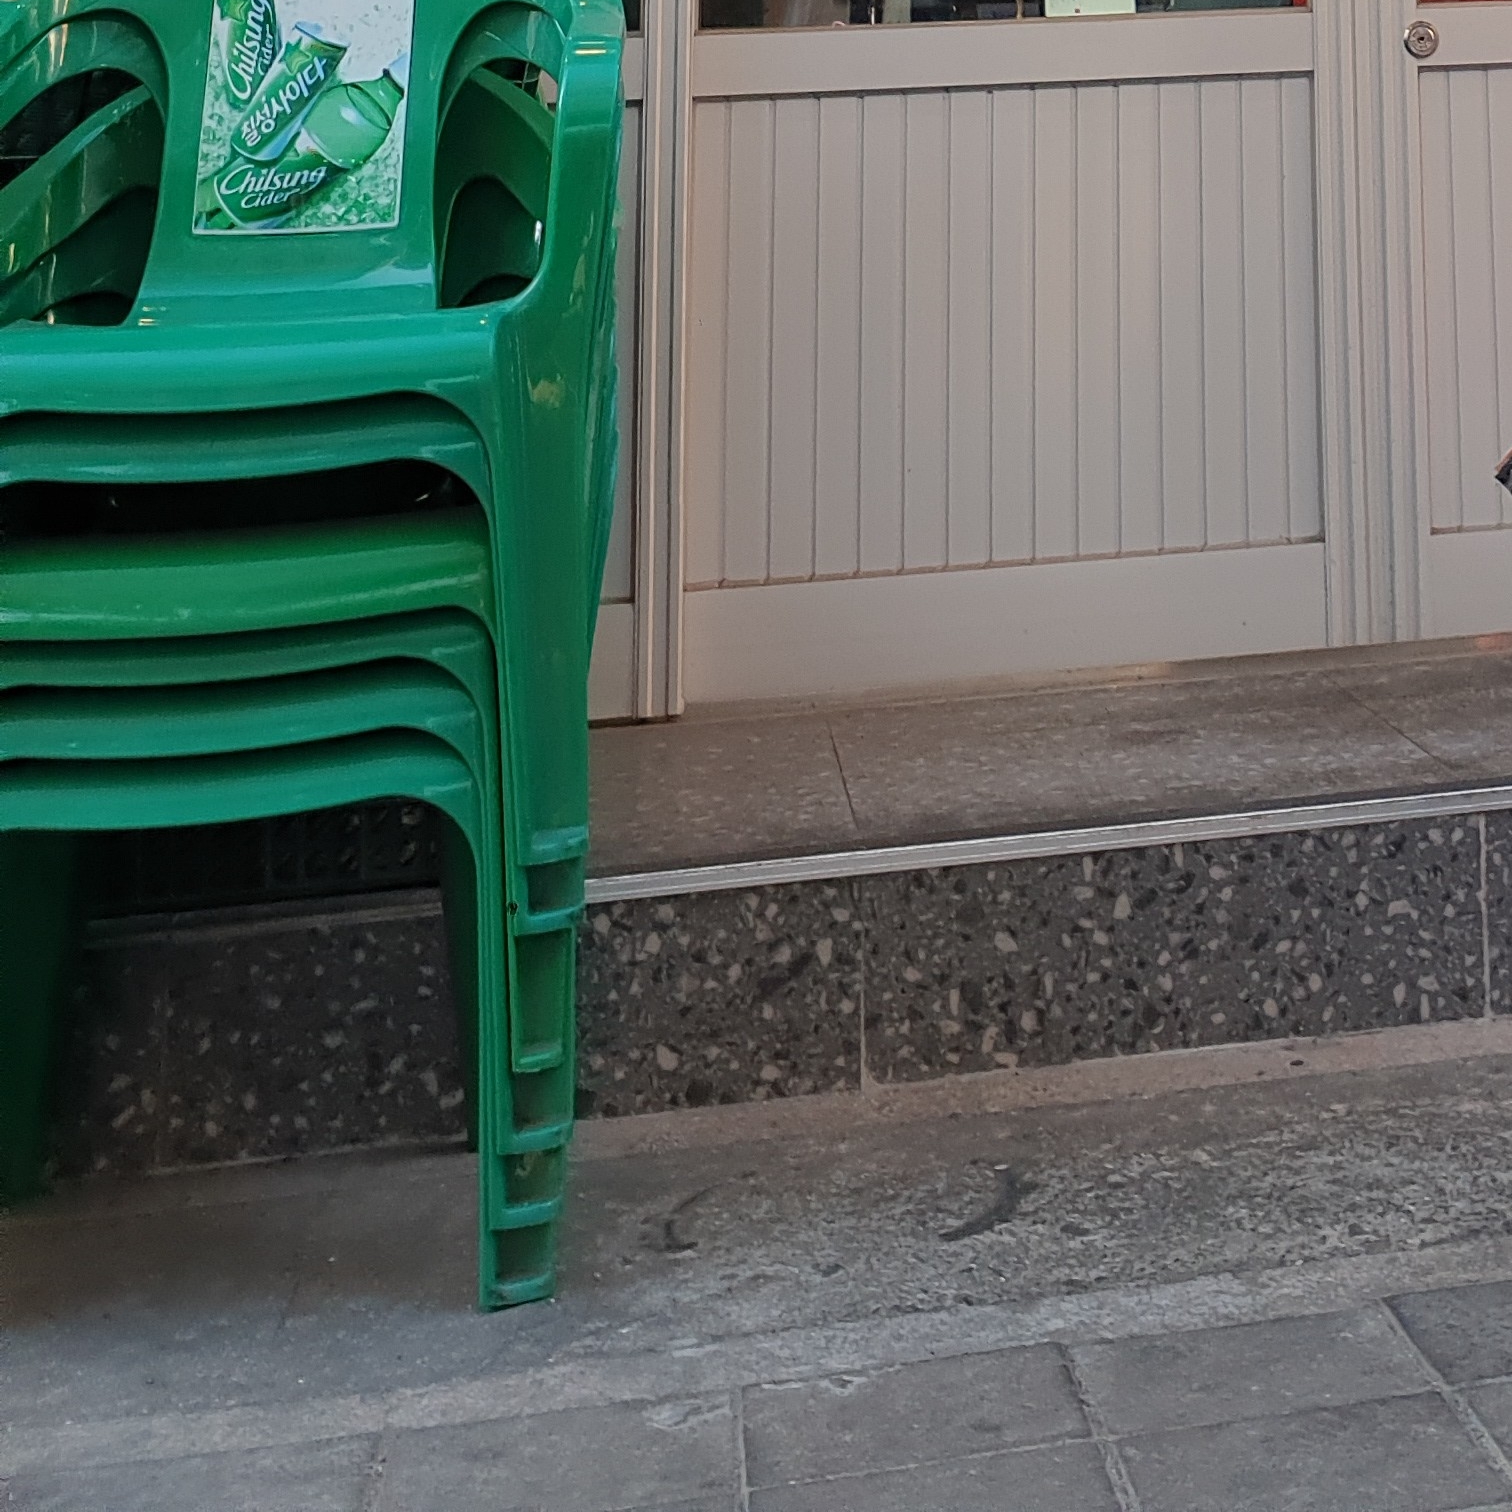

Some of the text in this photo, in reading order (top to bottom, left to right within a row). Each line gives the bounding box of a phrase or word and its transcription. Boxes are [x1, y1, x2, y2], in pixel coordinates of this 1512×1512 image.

[257, 24, 275, 76] Cider
[240, 57, 328, 147] 칠성사이다
[219, 163, 327, 197] Chilsung
[240, 188, 297, 209] Cider
